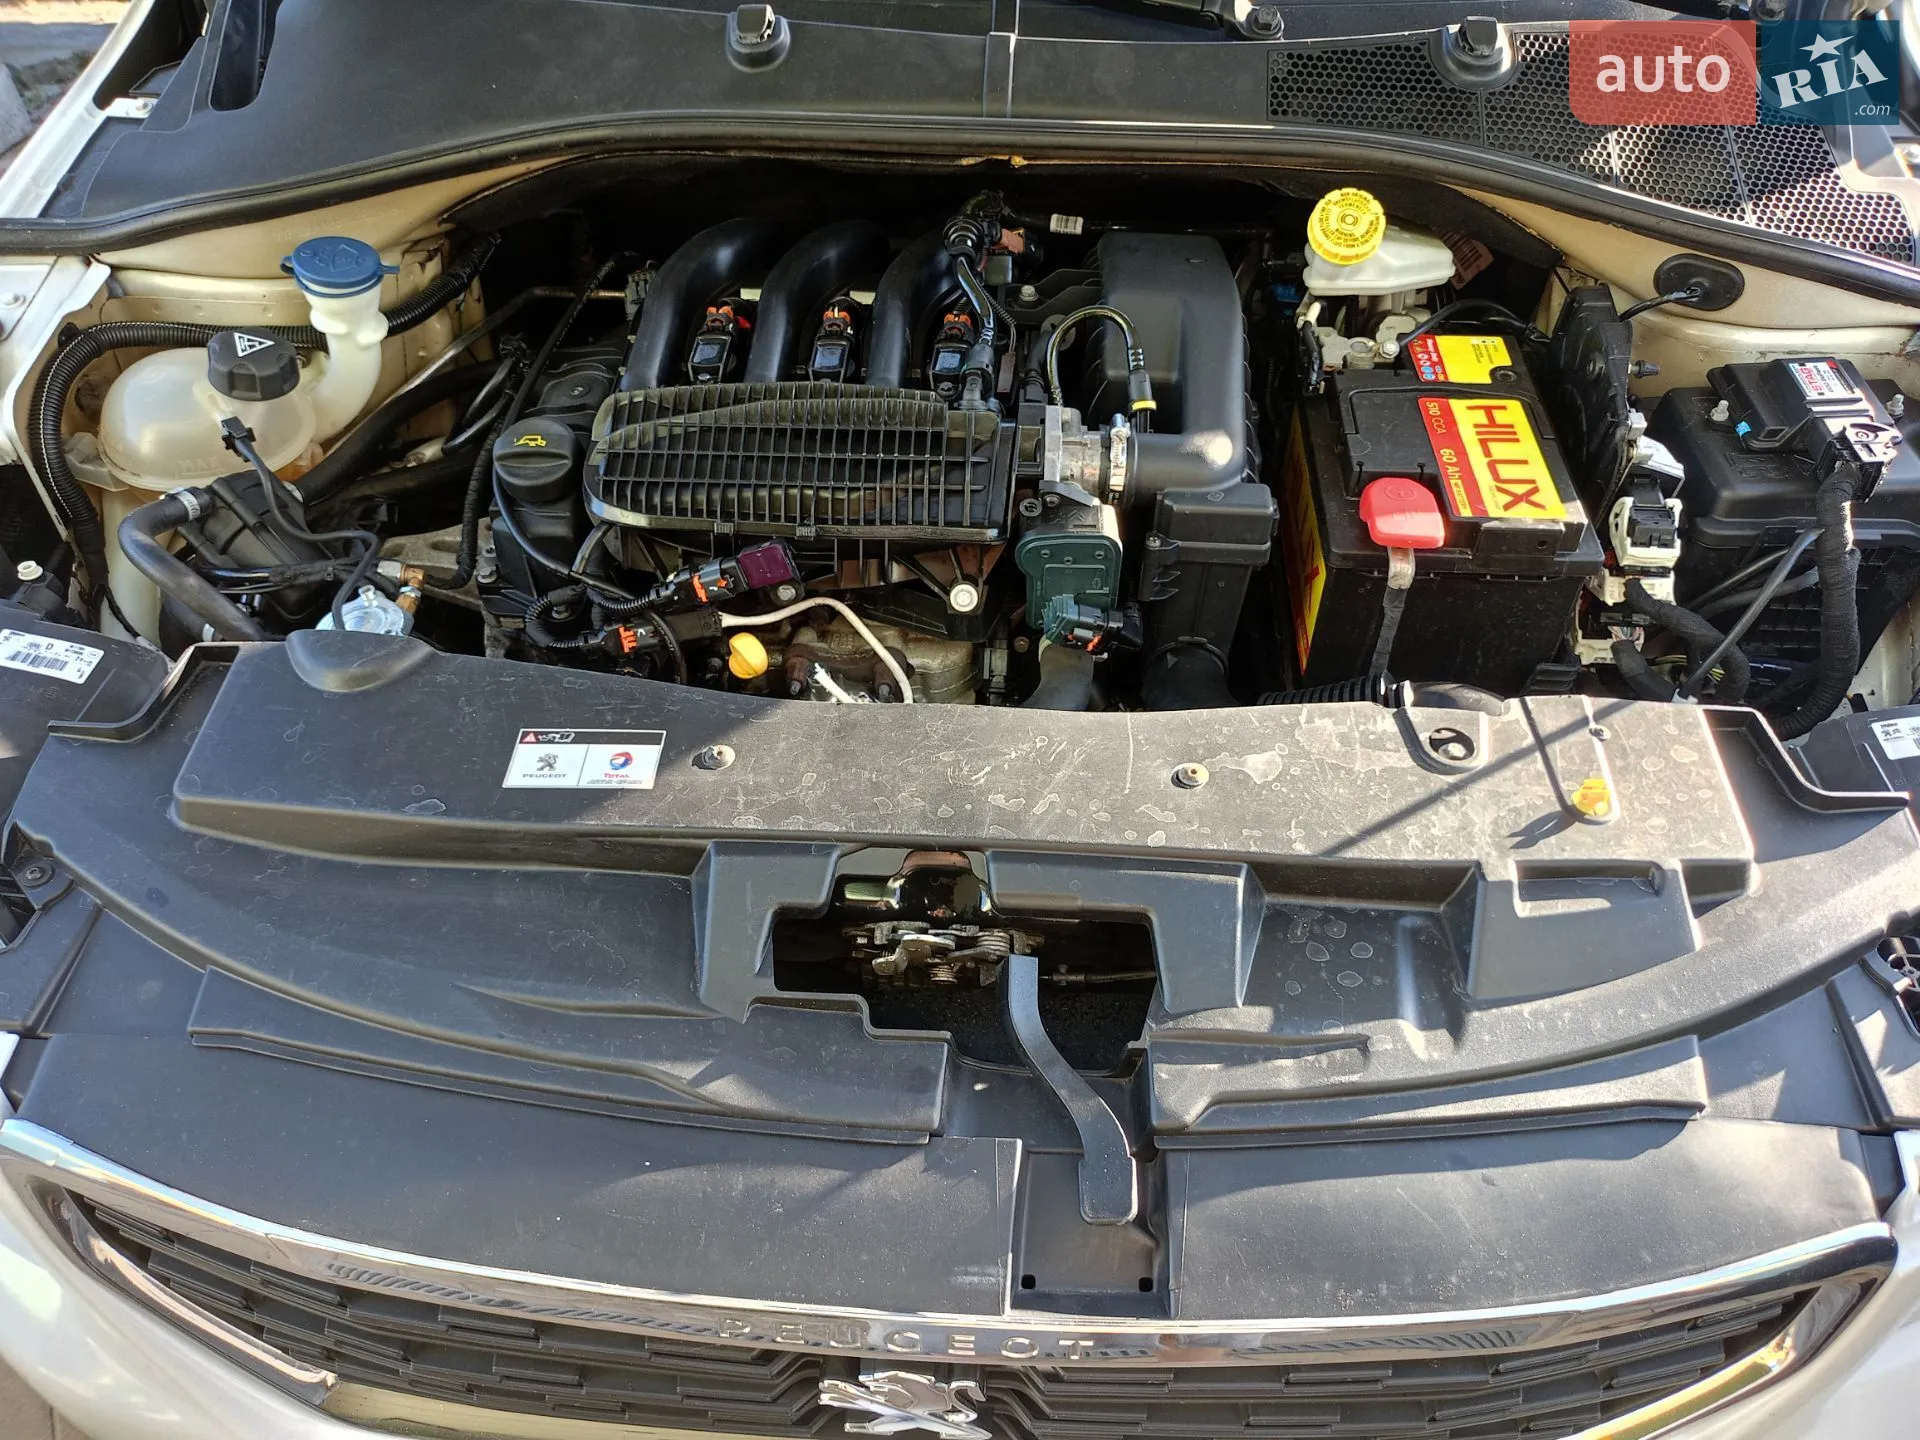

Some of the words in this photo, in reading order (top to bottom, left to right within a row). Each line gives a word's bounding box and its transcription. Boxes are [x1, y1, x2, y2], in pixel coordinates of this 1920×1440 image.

[1800, 367, 1823, 392] STAG
[1426, 402, 1439, 416] 510
[1432, 416, 1447, 434] CCA
[1440, 448, 1458, 463] 60
[1465, 405, 1547, 512] HILUX
[1445, 465, 1463, 480] Ah
[718, 1317, 1094, 1360] PEUGEOT
